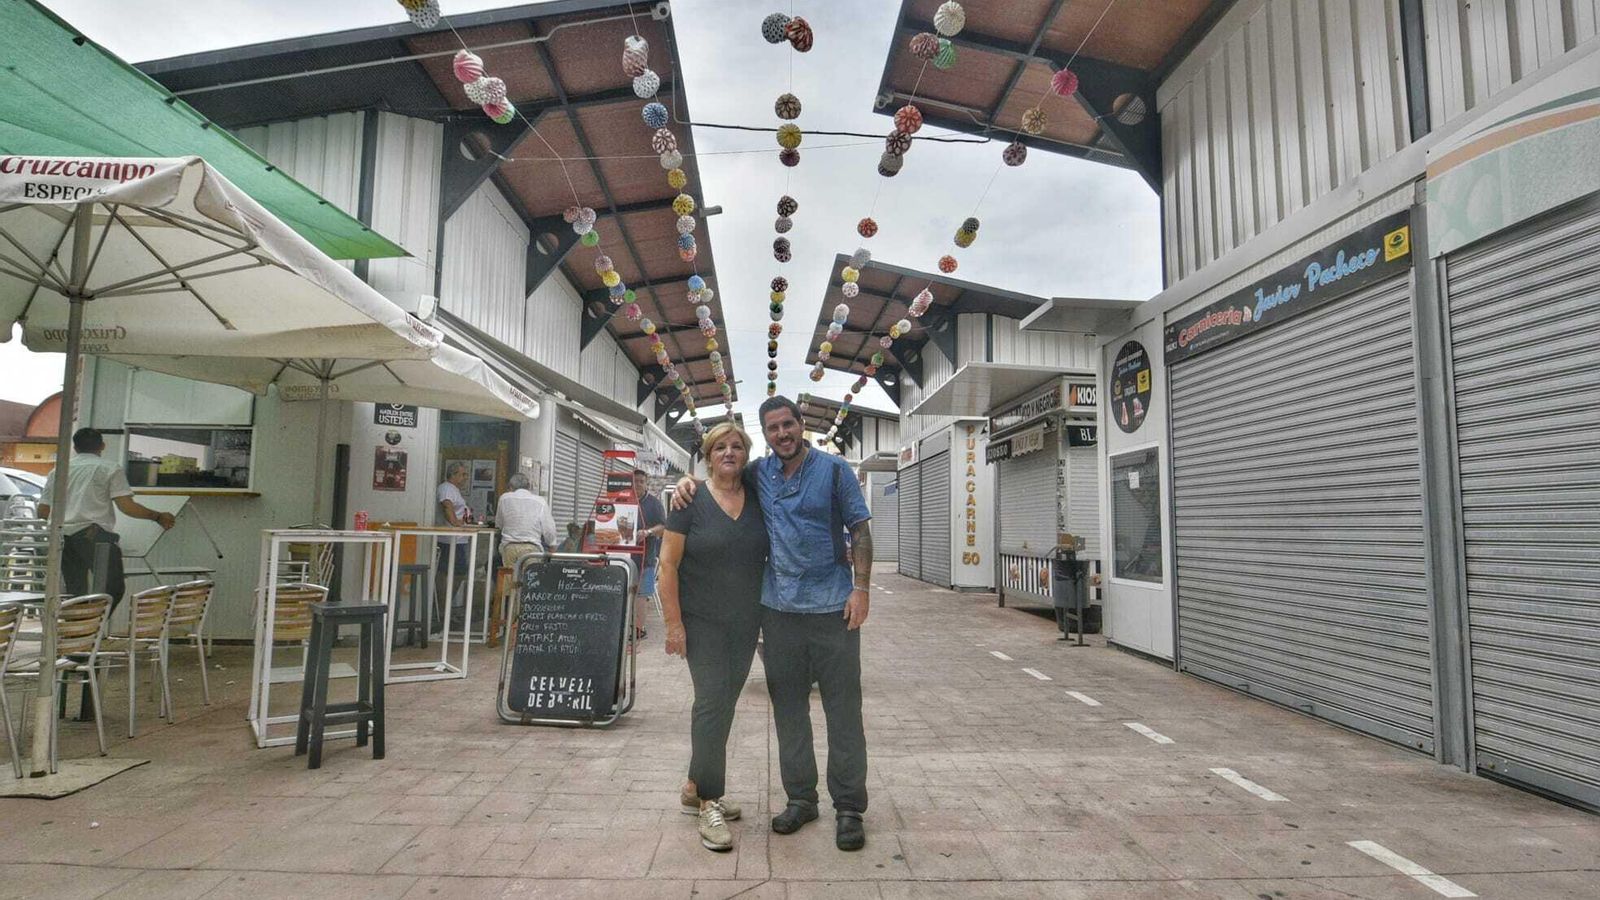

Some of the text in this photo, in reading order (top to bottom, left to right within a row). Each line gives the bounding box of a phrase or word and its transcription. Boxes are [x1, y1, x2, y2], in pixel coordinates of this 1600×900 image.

[0, 156, 156, 184] Cruzcampo
[1253, 287, 1302, 322] Javier
[1303, 248, 1380, 292] Pacheco
[379, 415, 414, 426] USTEDES
[962, 551, 981, 566] 50
[528, 692, 543, 708] DE
